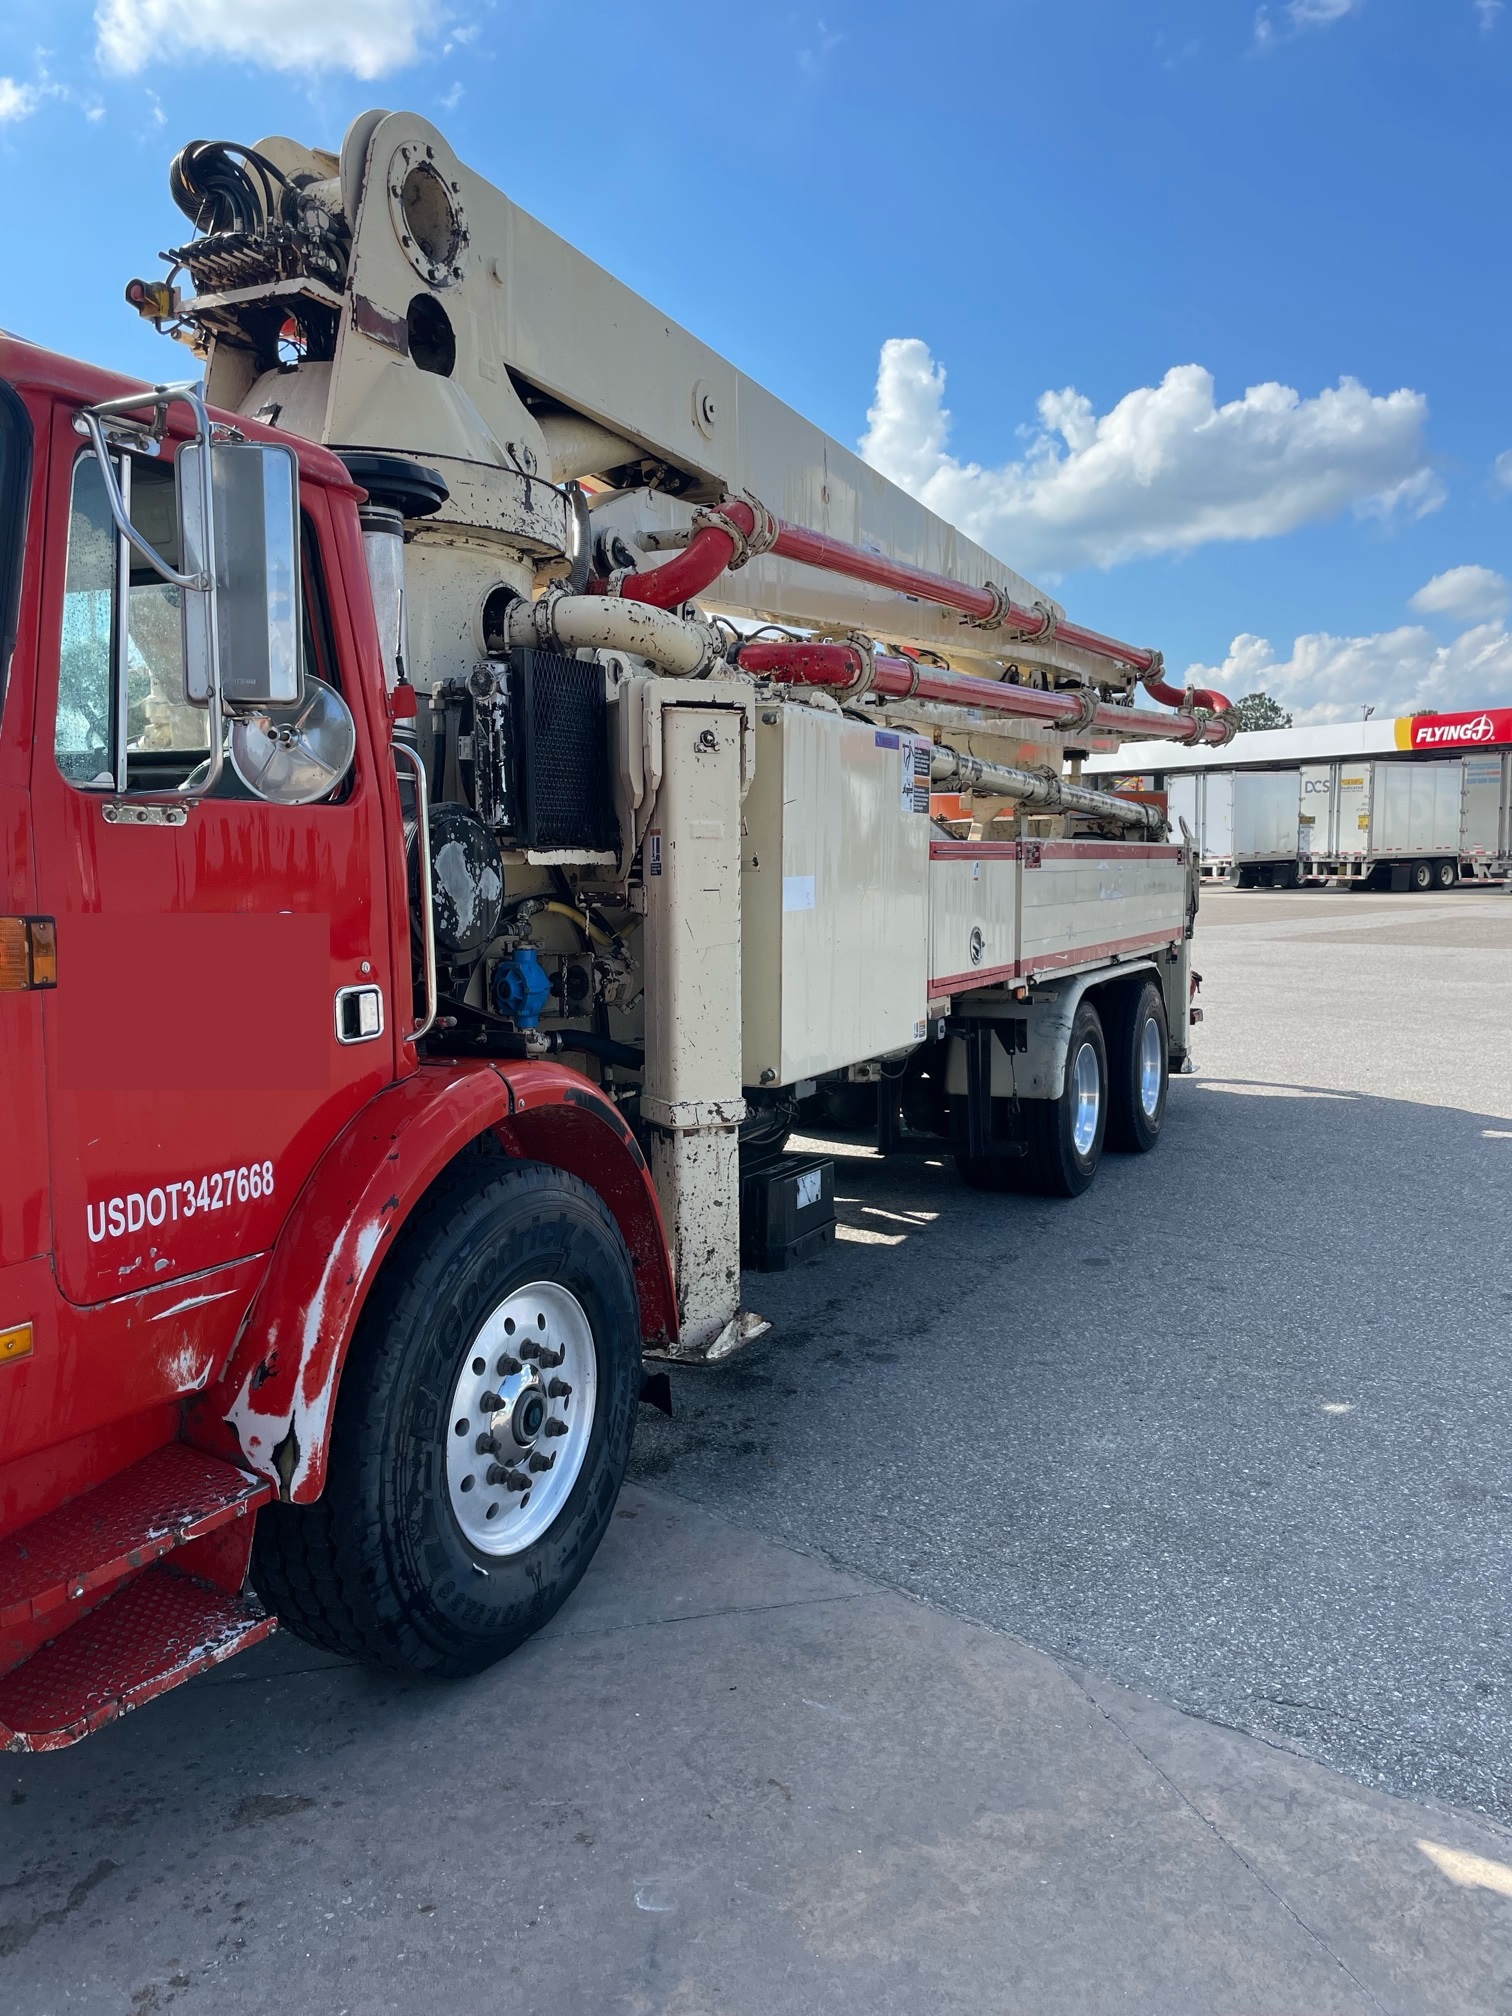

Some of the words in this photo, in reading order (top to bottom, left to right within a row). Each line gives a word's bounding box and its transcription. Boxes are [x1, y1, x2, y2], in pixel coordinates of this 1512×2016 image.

[1415, 723, 1473, 744] FLYING
[1304, 780, 1331, 794] DCS
[86, 1160, 275, 1243] USDOT3427668
